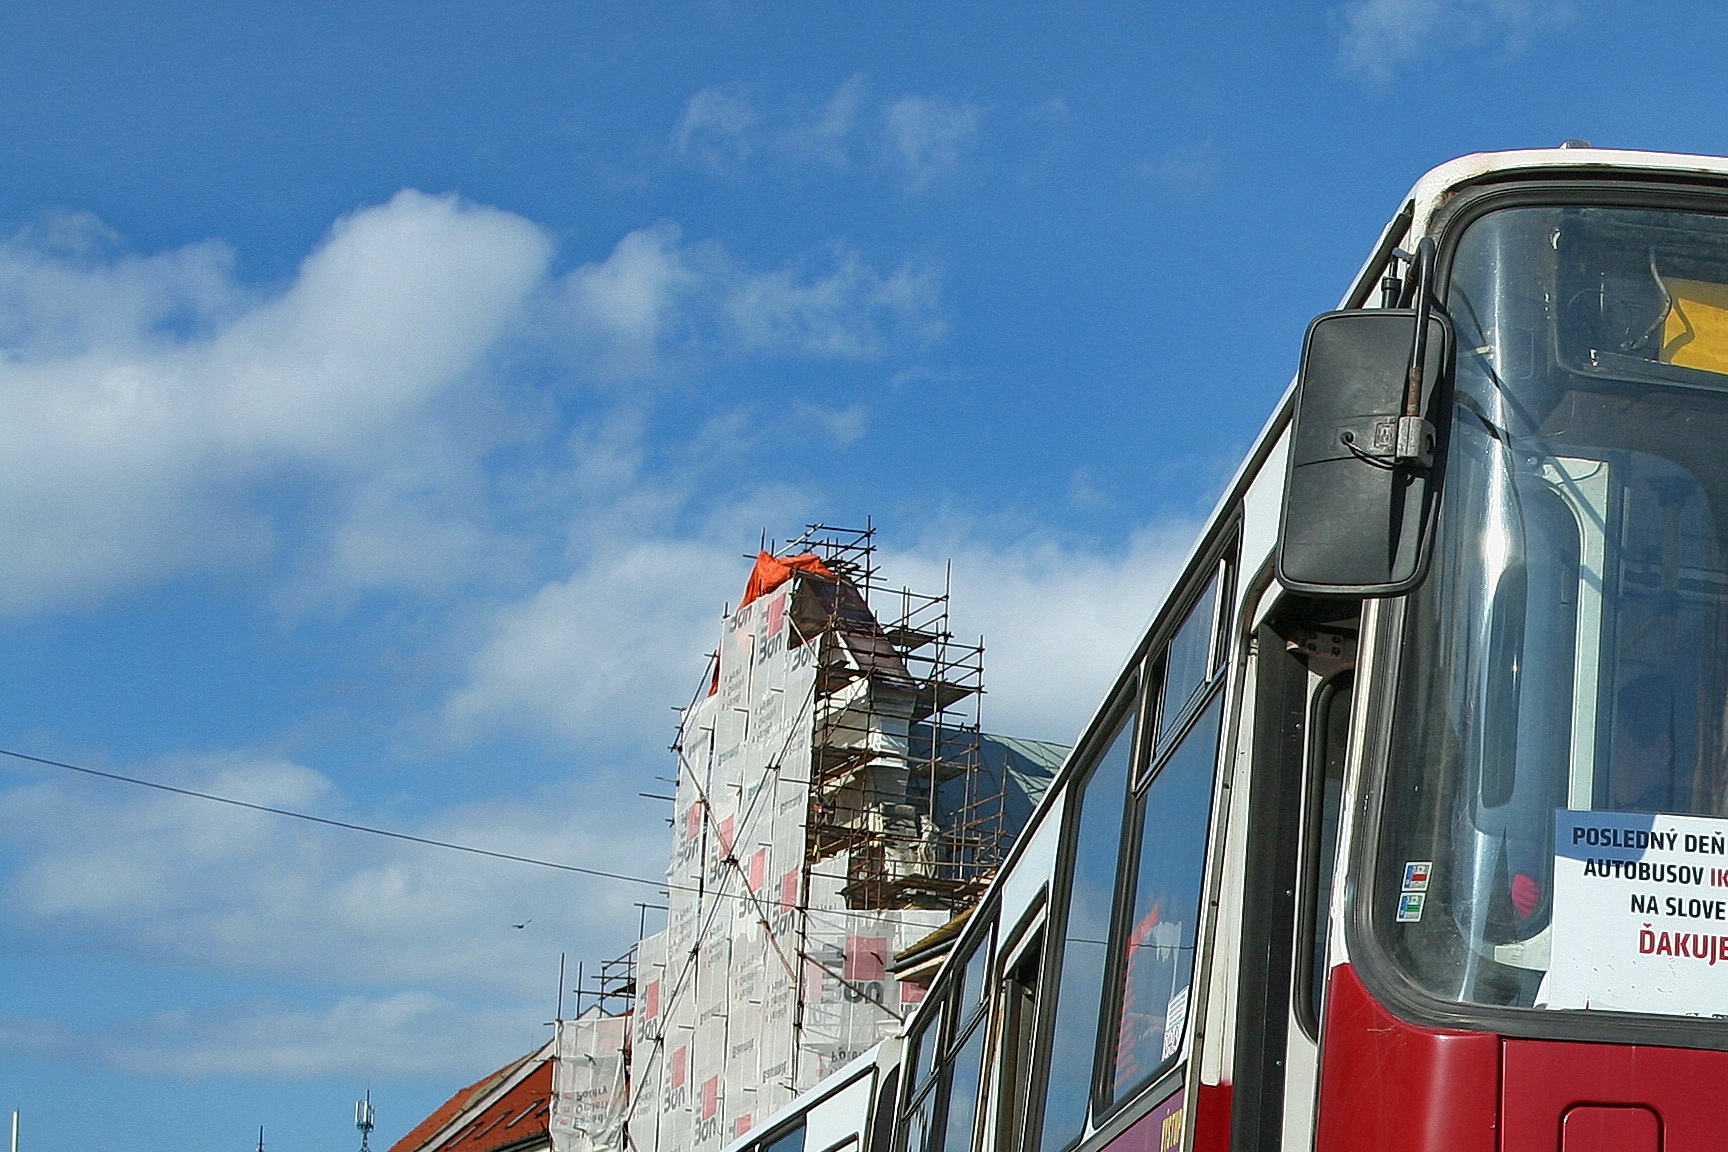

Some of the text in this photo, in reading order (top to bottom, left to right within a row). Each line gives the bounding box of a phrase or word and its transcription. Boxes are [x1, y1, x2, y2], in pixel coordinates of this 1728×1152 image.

[1572, 826, 1678, 852] POSLEDNÝ
[1684, 831, 1726, 856] DEŇ
[1583, 857, 1706, 886] AUTOBUSOV
[1630, 893, 1660, 916] NA
